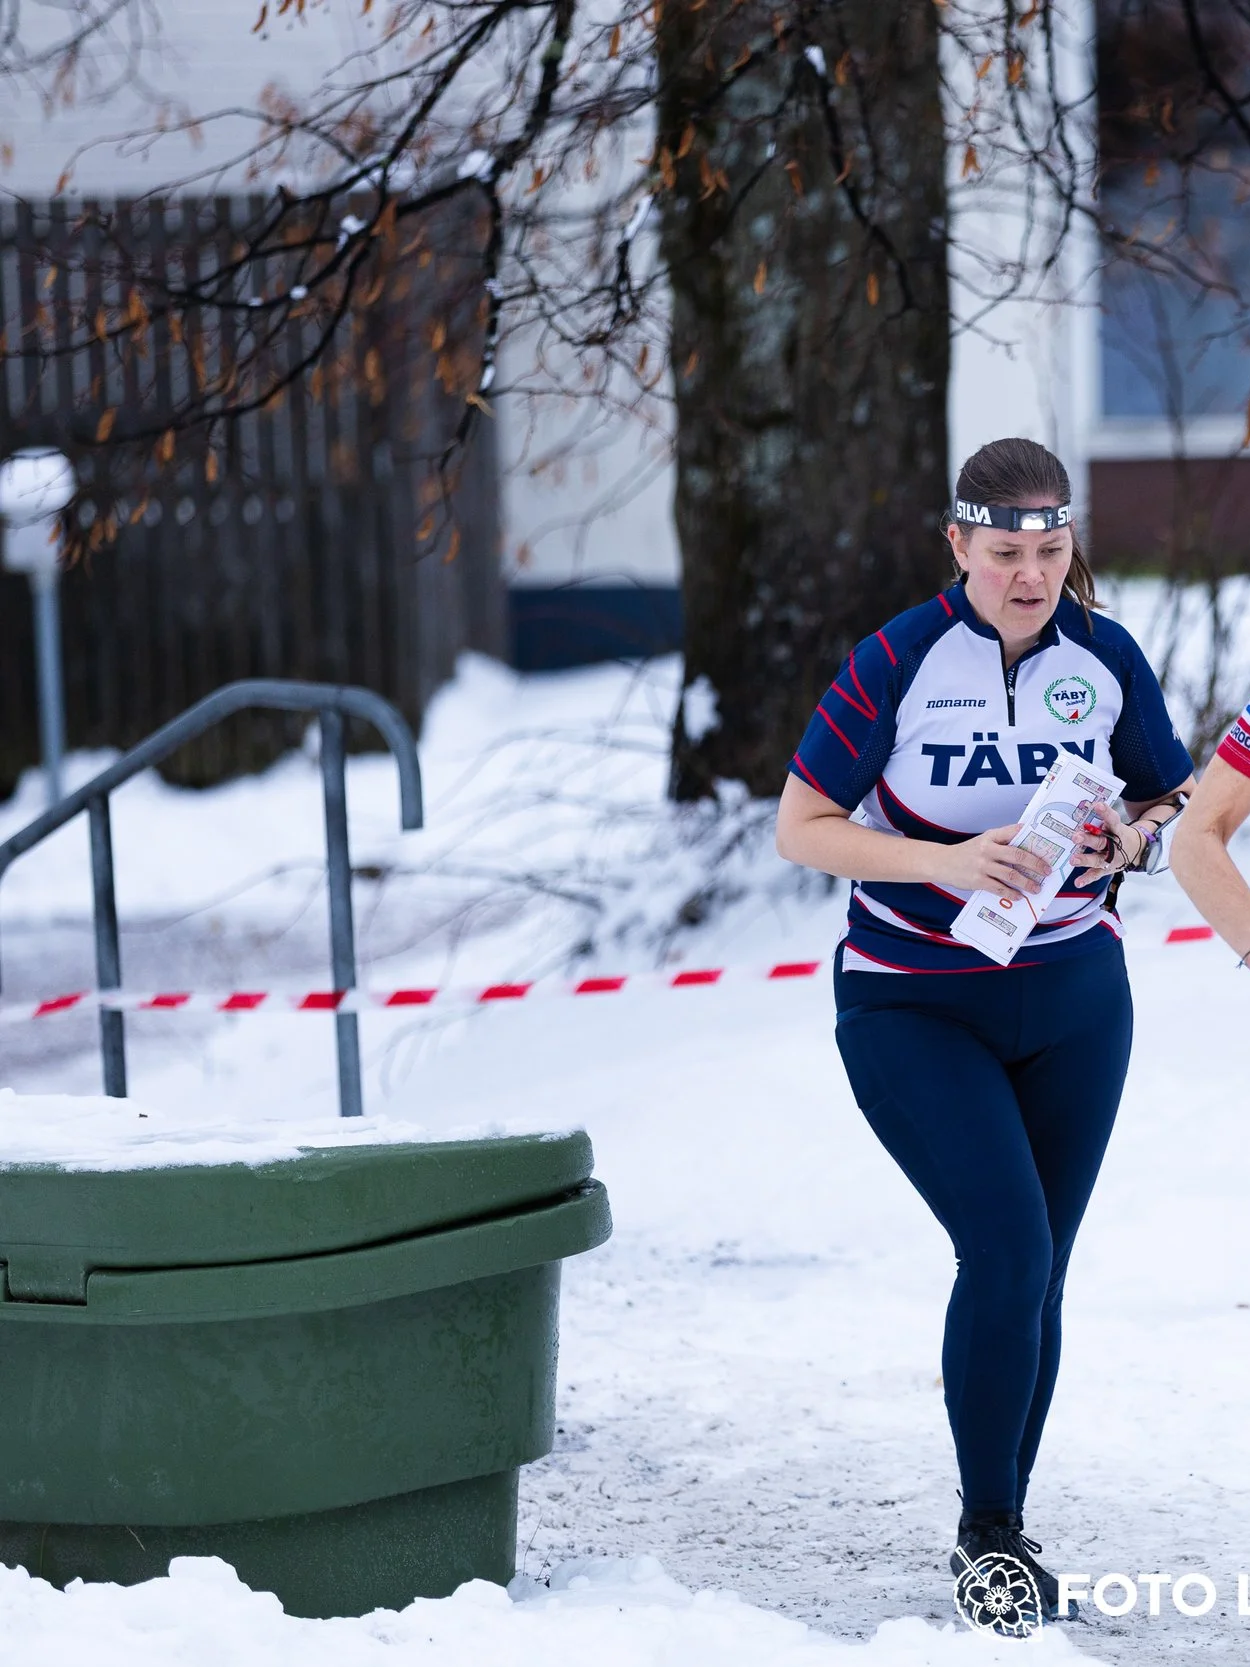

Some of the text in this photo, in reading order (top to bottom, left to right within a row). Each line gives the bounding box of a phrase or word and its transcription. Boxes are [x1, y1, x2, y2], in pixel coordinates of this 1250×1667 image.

[956, 500, 992, 526] SILVA
[1052, 690, 1087, 701] TÄBY
[925, 699, 987, 709] noname
